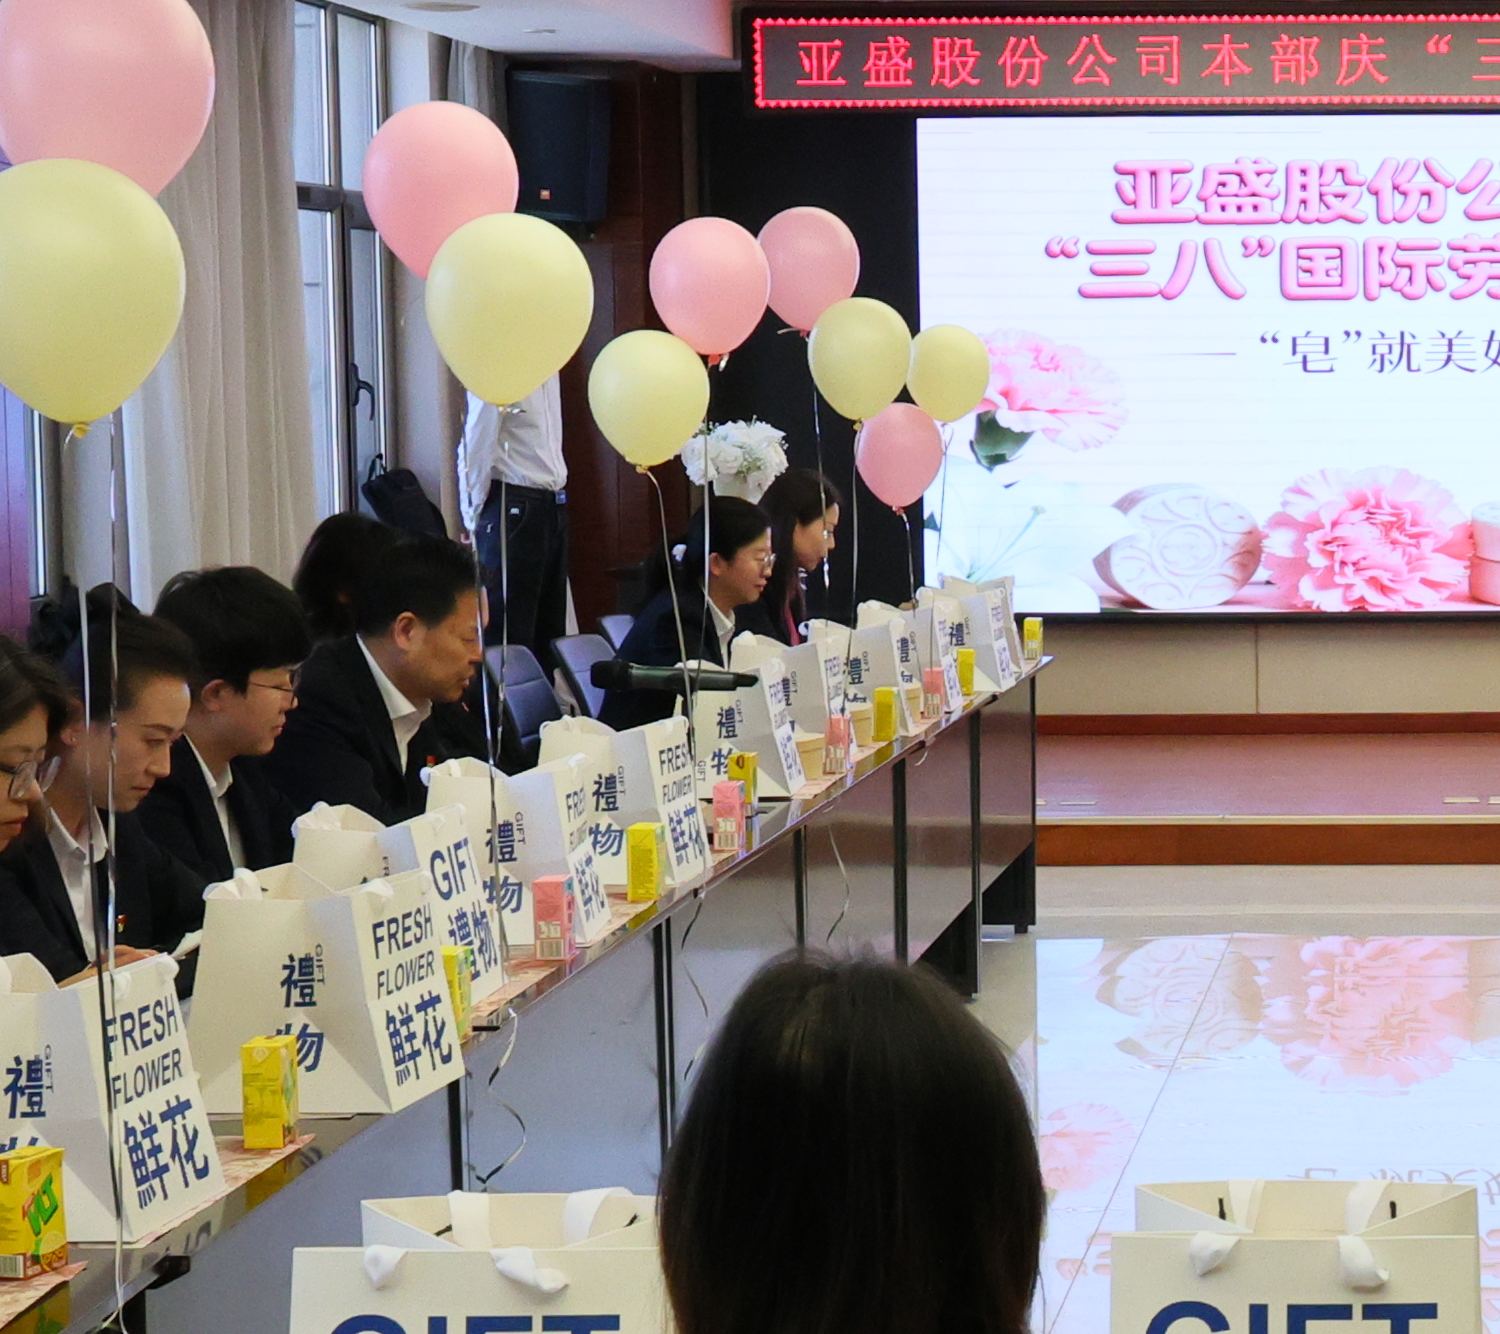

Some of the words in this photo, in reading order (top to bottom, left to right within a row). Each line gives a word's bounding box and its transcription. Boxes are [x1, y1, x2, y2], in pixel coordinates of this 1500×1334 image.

[617, 764, 627, 797] GIFT
[513, 810, 527, 846] GIFT
[588, 772, 624, 858] 禮物
[429, 835, 479, 902] GIFT
[482, 819, 524, 914] 禮物
[371, 901, 435, 961] FRESH
[314, 942, 326, 986] GIFT
[376, 949, 436, 1001] FLOWER
[103, 992, 180, 1064] FRESH
[384, 989, 455, 1087] 鮮花
[44, 1043, 55, 1095] GIFT
[110, 1047, 184, 1110] FLOWER
[122, 1093, 211, 1210] 鮮花
